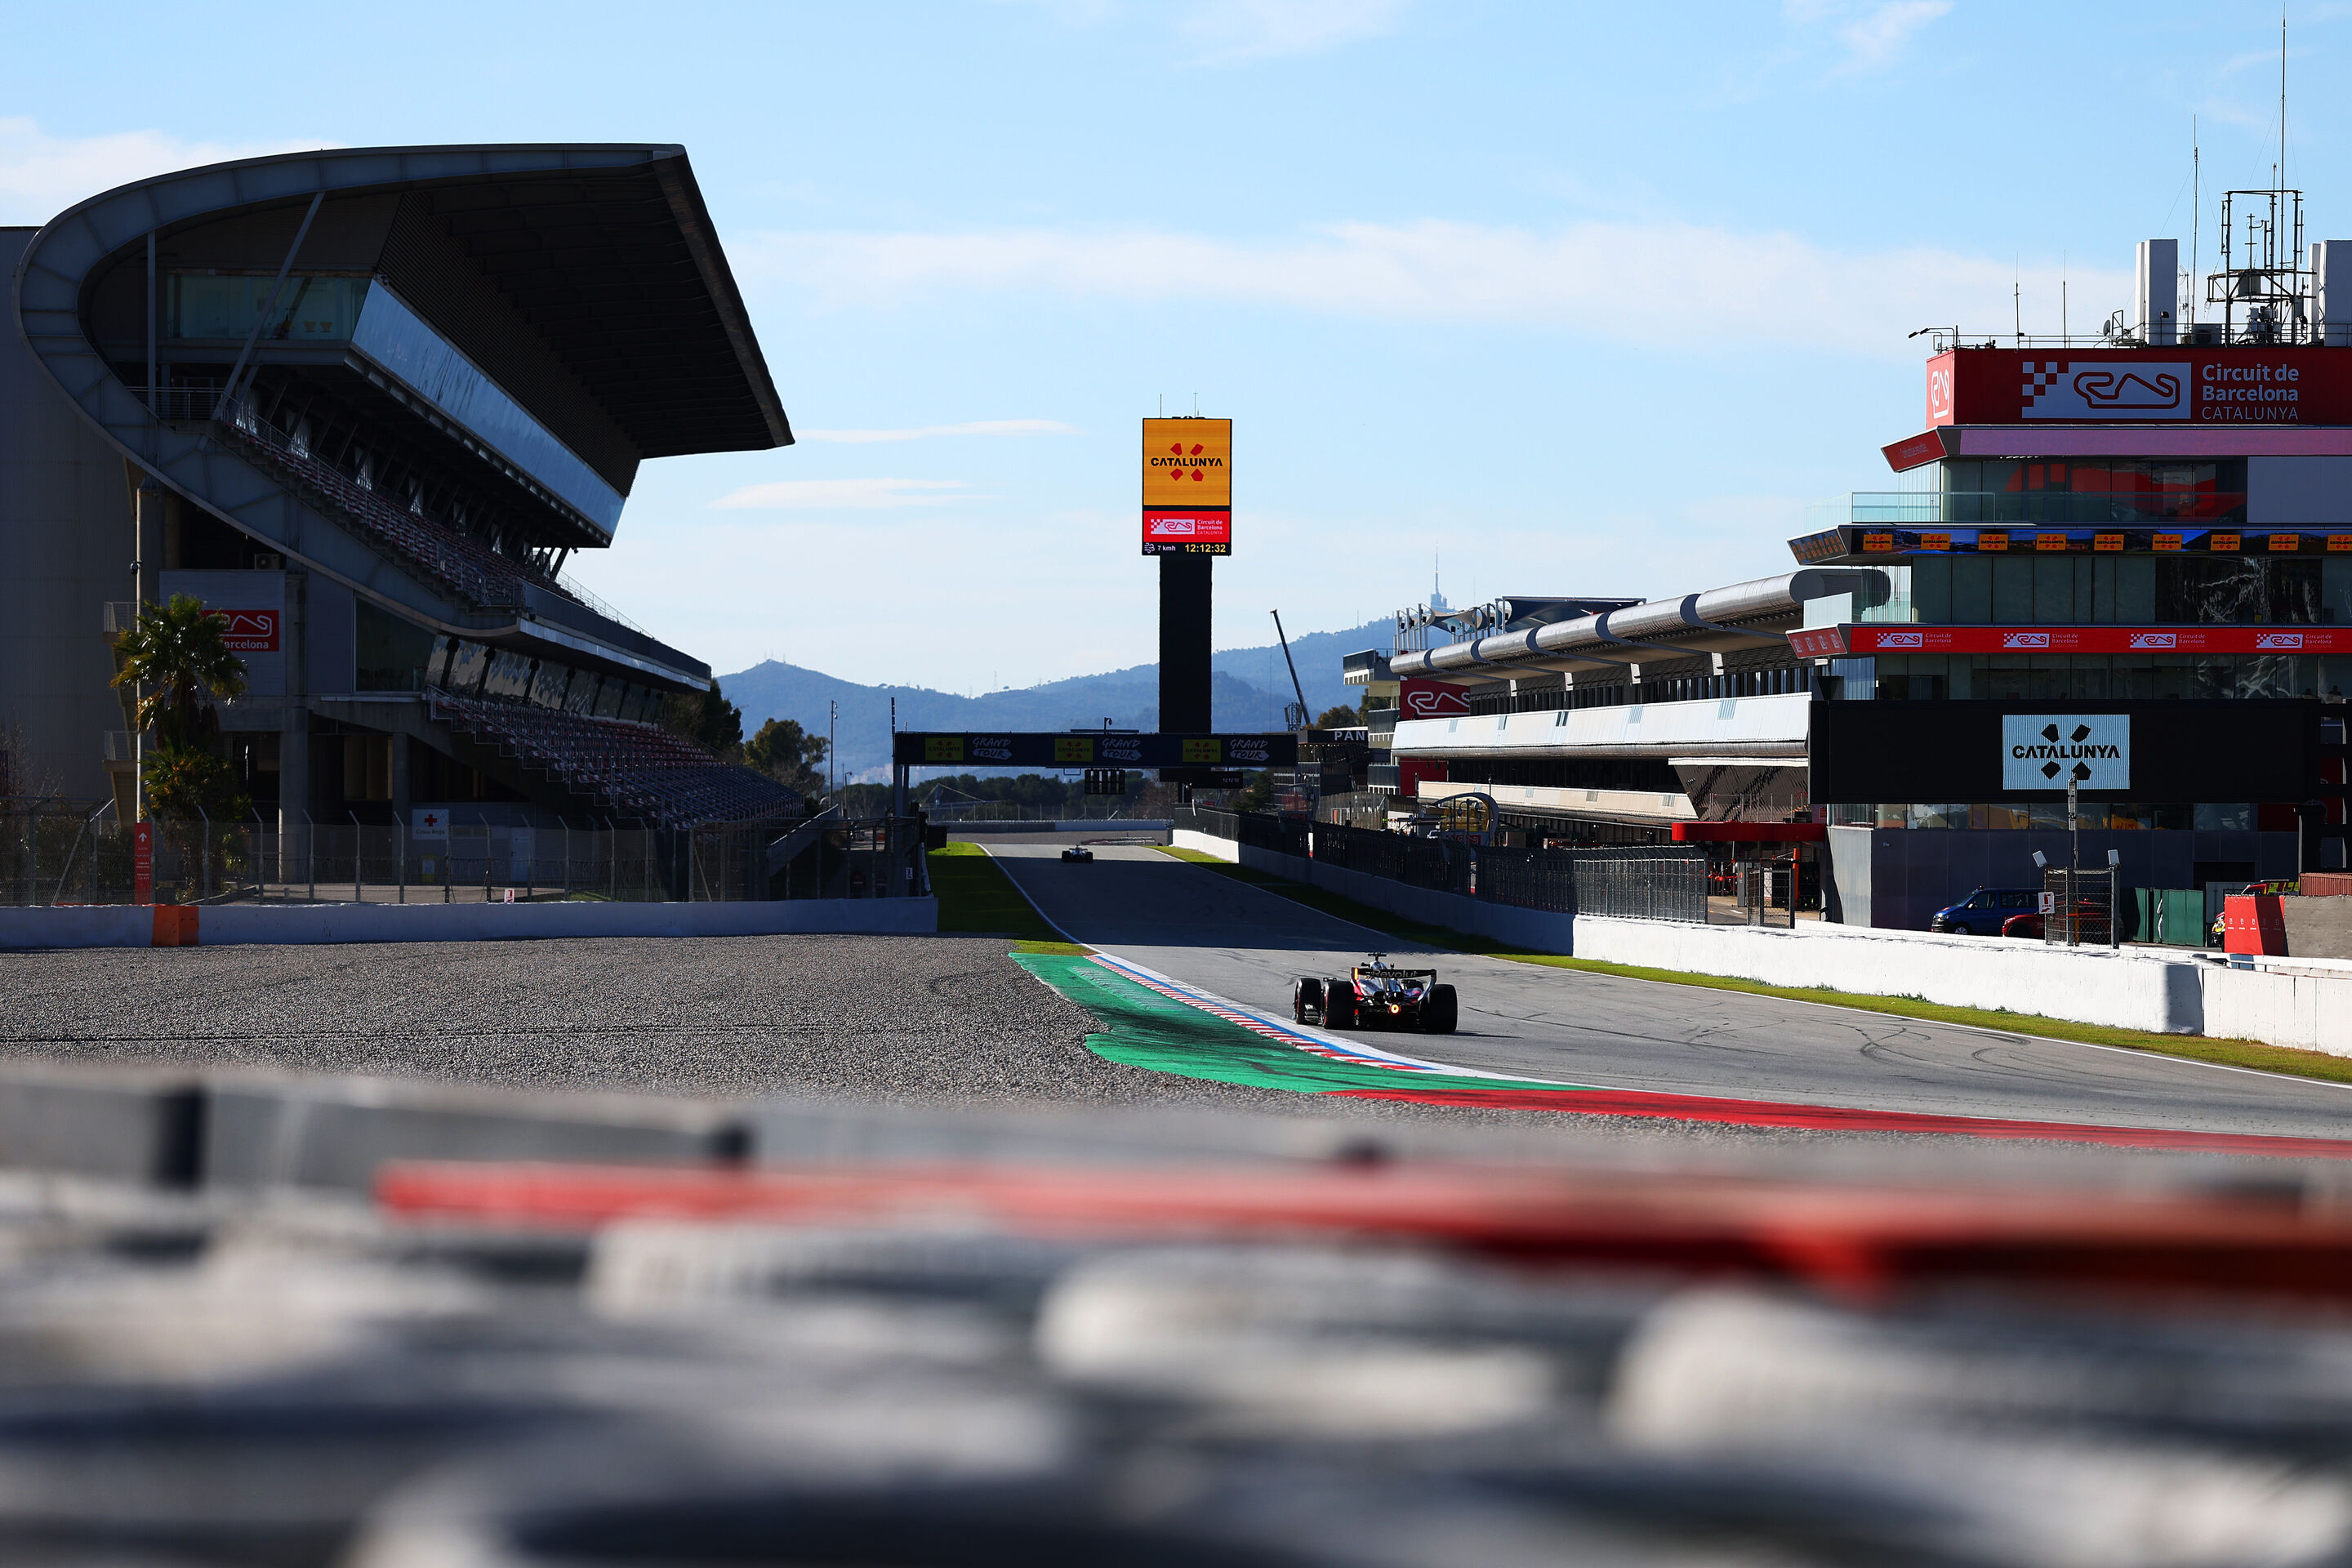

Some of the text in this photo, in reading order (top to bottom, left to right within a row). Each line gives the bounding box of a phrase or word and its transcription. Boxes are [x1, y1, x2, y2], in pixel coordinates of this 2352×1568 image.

[2202, 363, 2300, 381] Circuit de
[2203, 384, 2299, 402] Barcelona
[2202, 406, 2299, 420] CATALUNYA
[1150, 457, 1223, 467] CATALUNYA
[1185, 544, 1226, 552] 12:12:32
[1334, 730, 1365, 741] PAN
[973, 737, 1012, 746] GRAND
[1102, 738, 1141, 747] GRAND
[1230, 739, 1268, 748] GRAND
[980, 749, 1008, 758] TOUR
[1107, 751, 1136, 759] TOUR
[1235, 751, 1263, 760] TOUR
[2012, 745, 2120, 759] CATALUNYA
[1372, 969, 1418, 978] Revolut
